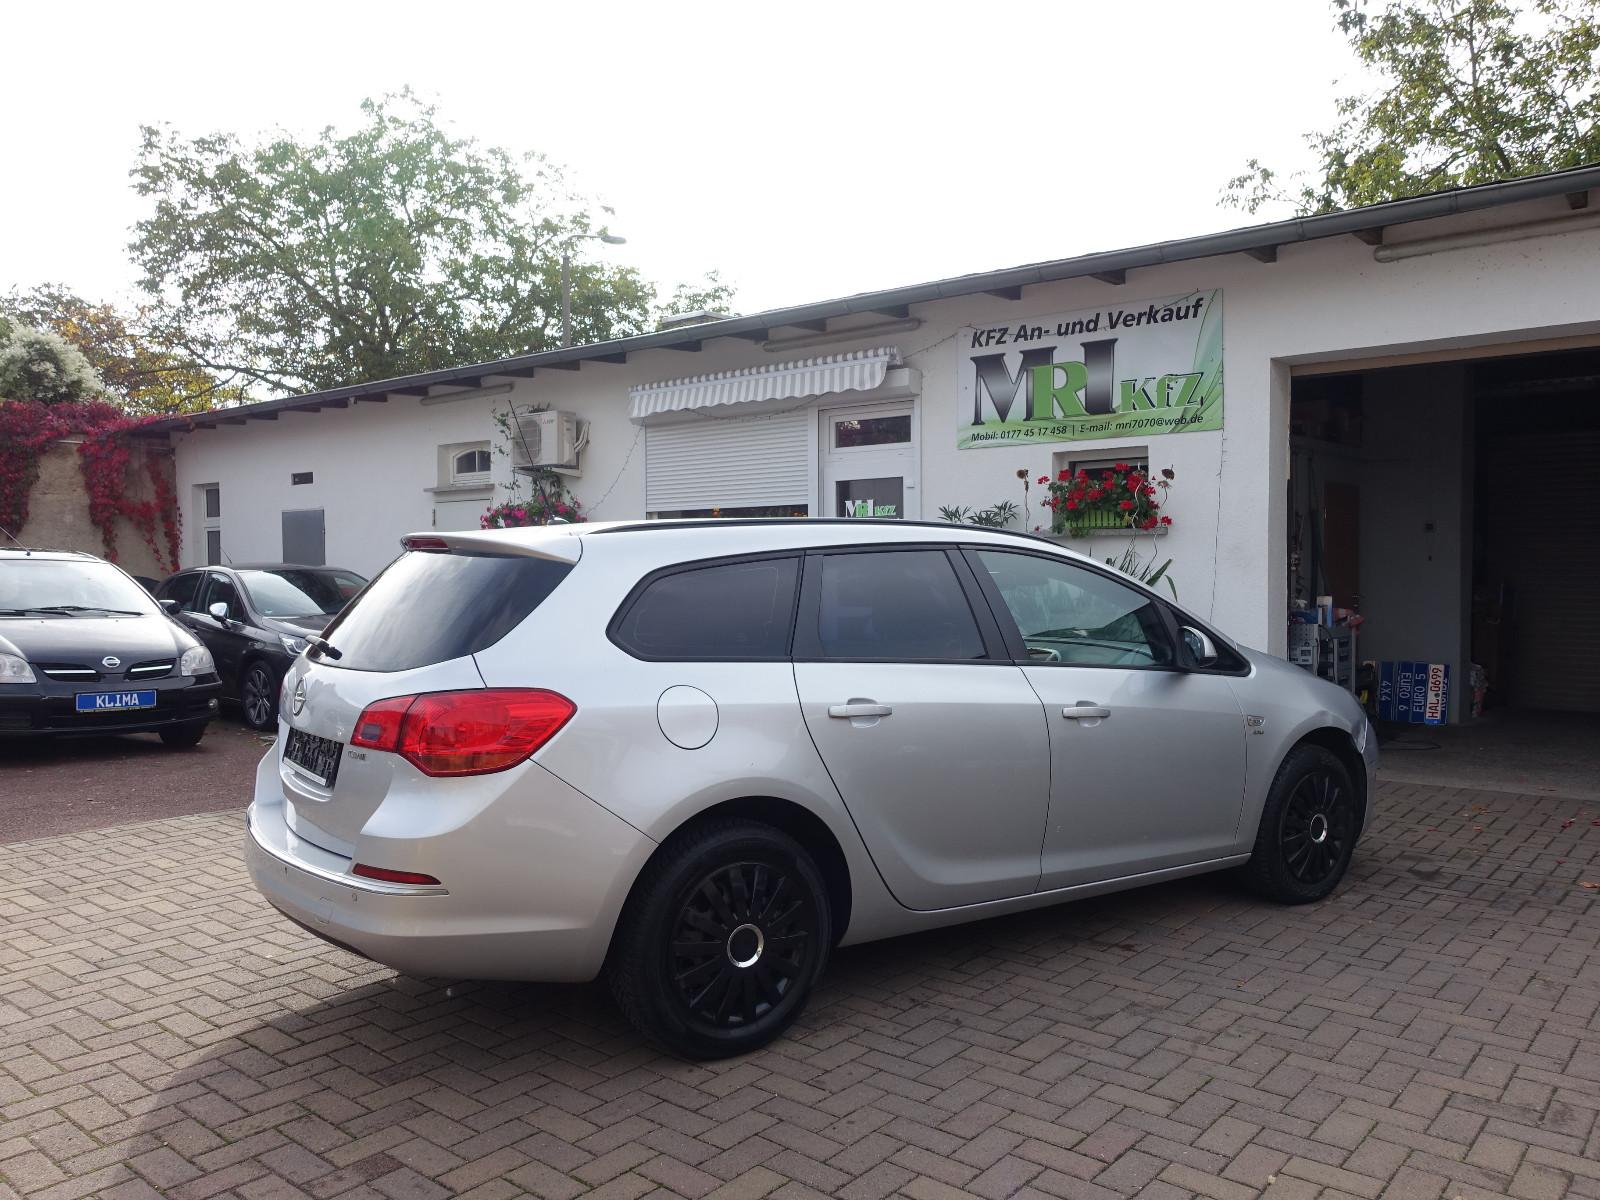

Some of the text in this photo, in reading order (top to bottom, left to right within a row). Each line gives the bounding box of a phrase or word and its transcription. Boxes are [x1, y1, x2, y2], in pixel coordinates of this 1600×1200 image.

[971, 298, 1203, 348] KFZ An- und Verkauf
[970, 338, 1119, 425] MRI
[971, 414, 1204, 442] Mobil: 0177 45 17 458 E-mail: mri7070@web.de
[1399, 672, 1411, 699] EURO
[1413, 686, 1425, 712] EURO
[96, 693, 139, 707] KLIMA
[1428, 699, 1439, 718] HAL
